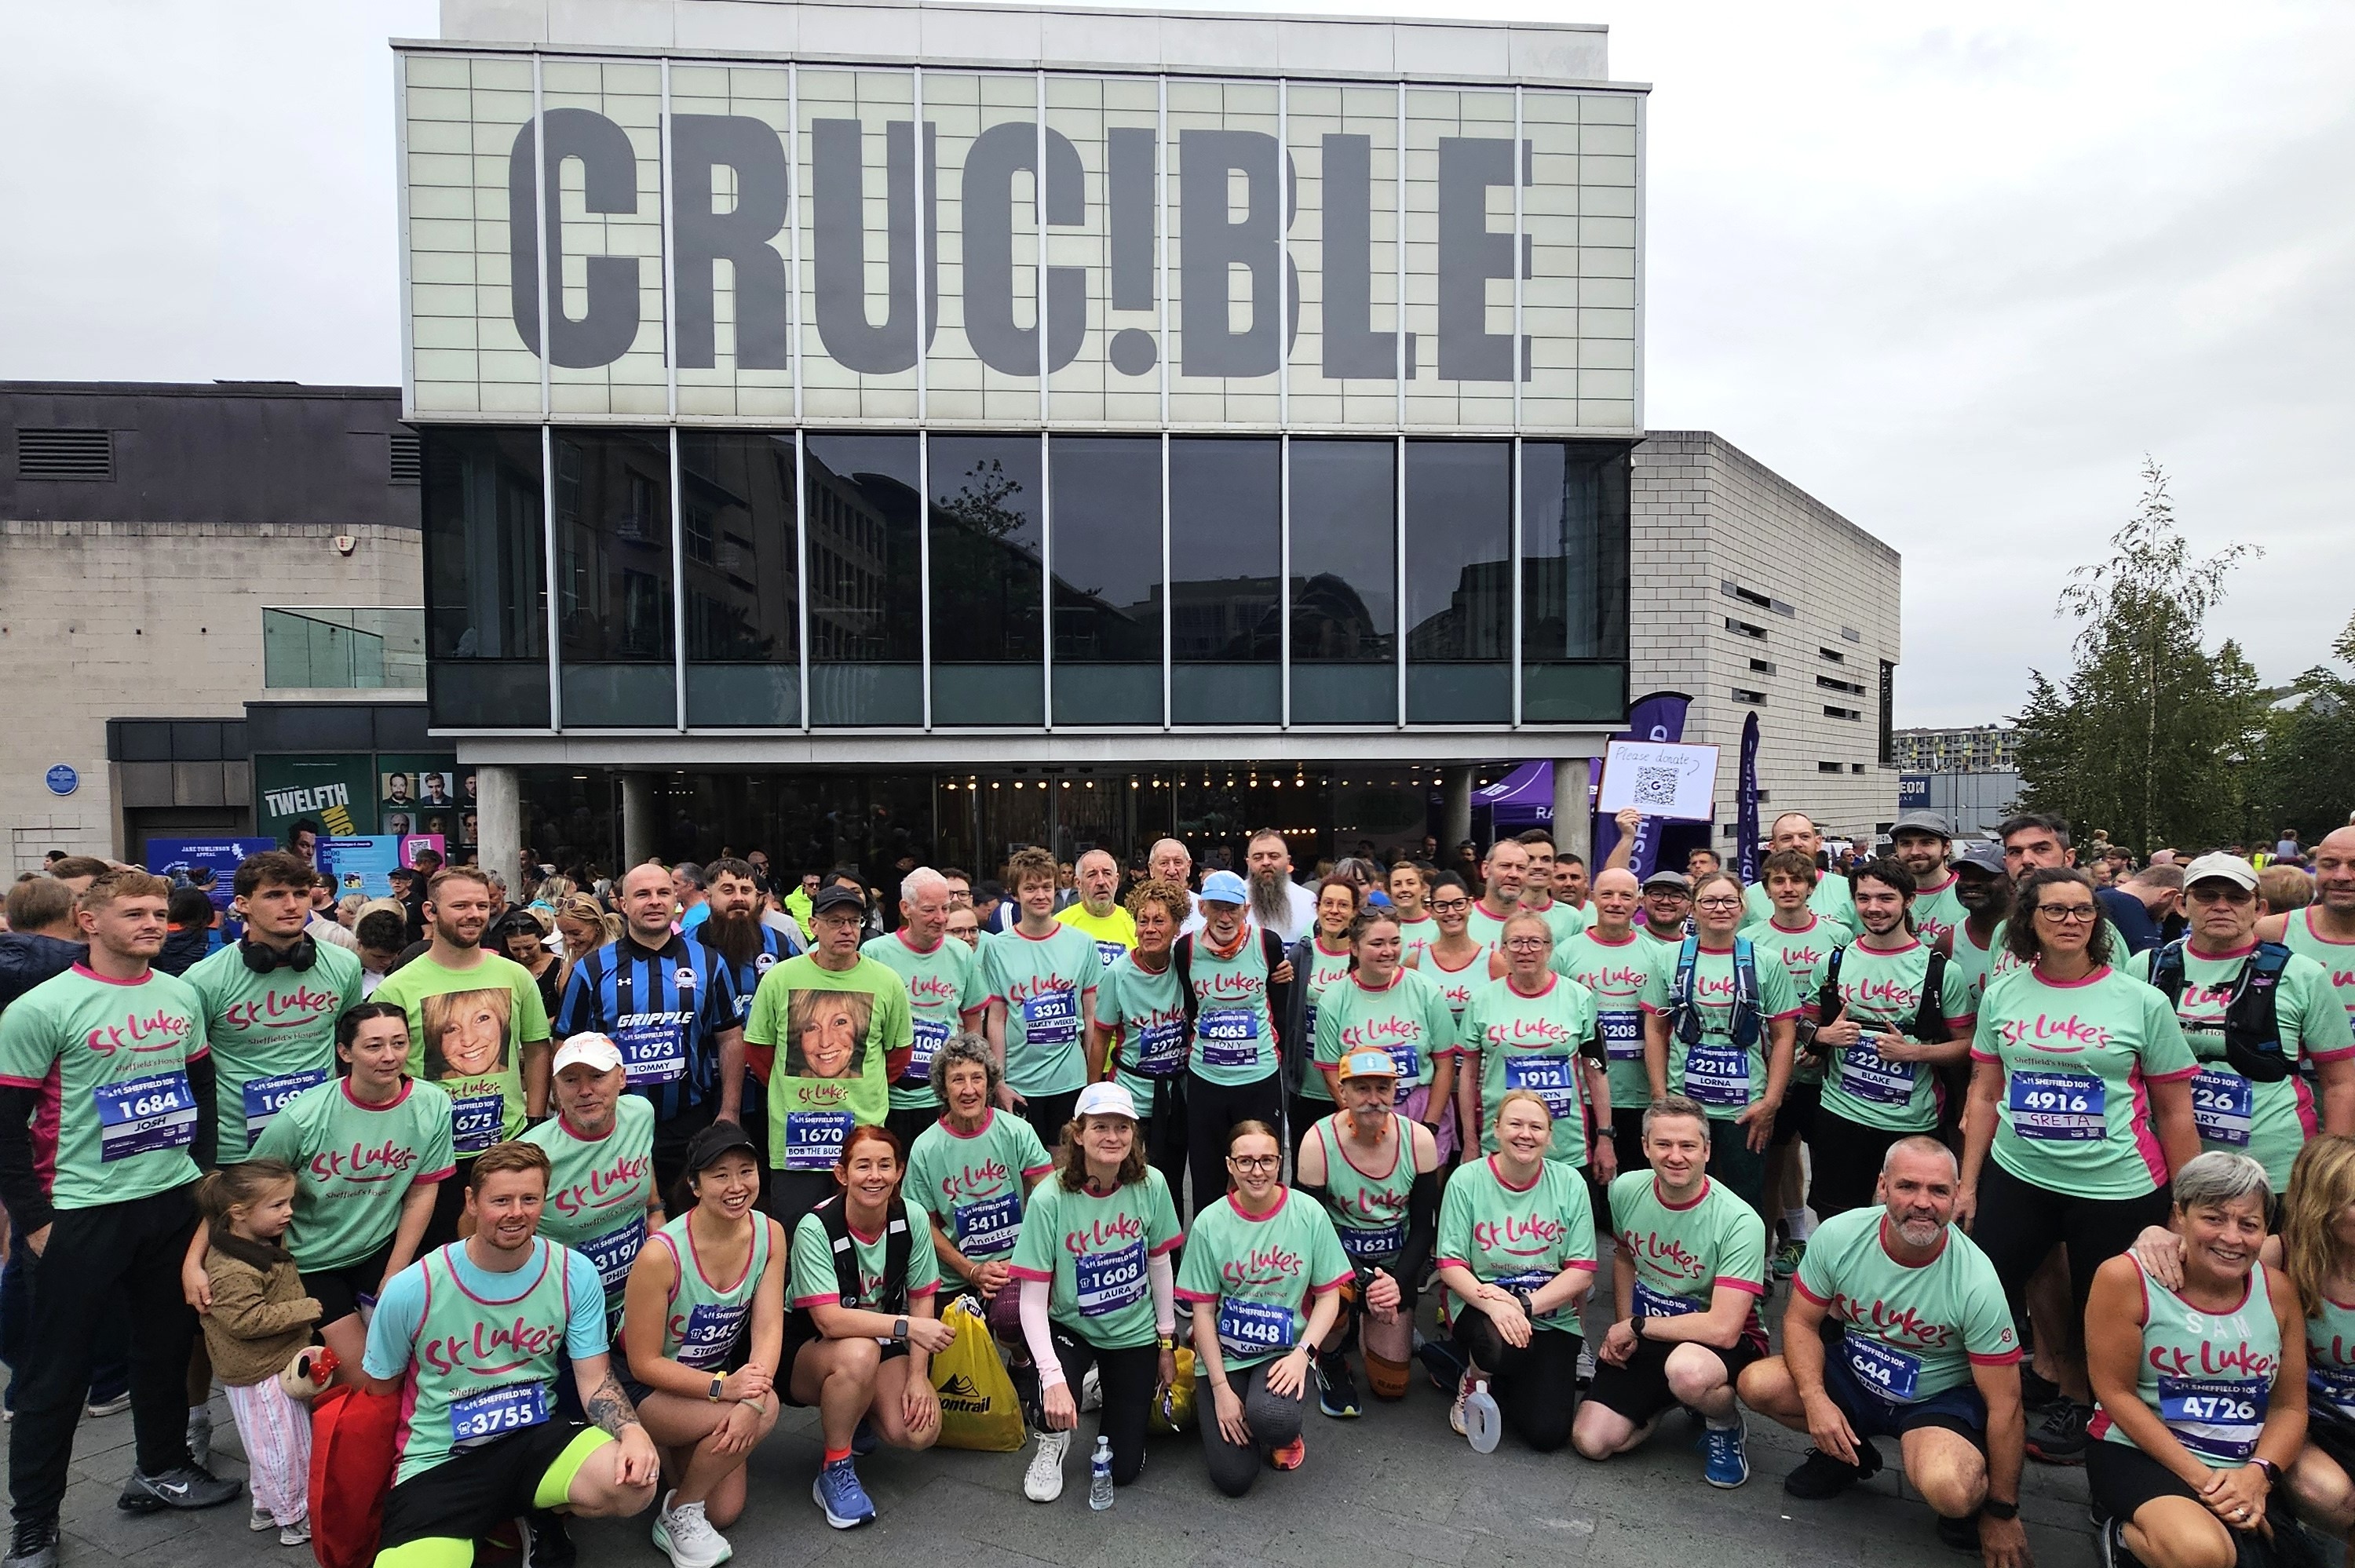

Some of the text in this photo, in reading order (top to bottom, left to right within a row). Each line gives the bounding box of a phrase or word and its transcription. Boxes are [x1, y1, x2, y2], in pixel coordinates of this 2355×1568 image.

[509, 108, 1532, 381] CRUC!BLE
[1615, 746, 1690, 765] Please donate
[1900, 782, 1925, 793] EON
[265, 783, 349, 817] TWELFTH
[321, 804, 358, 837] NIG
[911, 975, 957, 1001] Luke's
[1193, 971, 1264, 1000] St Luke's
[1861, 978, 1921, 1008] Luke's
[226, 986, 338, 1030] St Luke's
[1034, 1003, 1067, 1018] 3321
[617, 1011, 695, 1027] GRIPPLE
[88, 1009, 192, 1059] St Luke's
[633, 1031, 663, 1040] SHEFFIELD
[1209, 1025, 1247, 1037] 5065
[1342, 1016, 1422, 1050] St Luke's
[1487, 1018, 1570, 1047] St Luke's
[2001, 1013, 2114, 1048] St Luke's
[630, 1041, 674, 1059] 1673
[915, 1035, 942, 1051] 108
[1150, 1036, 1183, 1054] 5272
[1211, 1040, 1243, 1049] TONY
[115, 1060, 157, 1072] Sheffield's
[634, 1062, 670, 1073] TOMMY
[1695, 1059, 1738, 1075] 2214
[1856, 1052, 1903, 1074] 2216
[2014, 1056, 2057, 1067] Sheffield's
[122, 1078, 175, 1094] SHEFFIELD 10K
[266, 1078, 301, 1089] SHEFFIELD
[462, 1079, 501, 1096] Luke's
[1518, 1070, 1561, 1086] 1912
[1700, 1078, 1731, 1086] LORNA
[1861, 1072, 1891, 1085] BLAKE
[2035, 1078, 2073, 1088] SHEFFIELD
[2221, 1078, 2239, 1088] 10K
[798, 1084, 849, 1103] St Luke's
[2024, 1092, 2088, 1112] 4916
[119, 1092, 179, 1118] 1684
[134, 1117, 167, 1132] JOSH
[455, 1113, 492, 1130] 675
[2030, 1114, 2090, 1126] GRETA
[2194, 1113, 2220, 1125] ARY
[799, 1128, 843, 1142] 1670
[311, 1140, 418, 1182] St Luke's
[555, 1154, 648, 1218] St Luke's
[942, 1175, 962, 1202] St
[972, 1198, 1011, 1214] SHEFFIELD 10K
[968, 1211, 1009, 1231] 5411
[601, 1231, 630, 1248] SHEFFIELD
[967, 1228, 1013, 1245] Annette
[1474, 1213, 1567, 1251] St Luke's
[1065, 1230, 1090, 1256] St
[1354, 1238, 1393, 1252] 1621
[594, 1237, 639, 1271] 3197
[1097, 1249, 1138, 1267] SHEFFIELD 10K
[1625, 1230, 1706, 1279] St Luke's
[1092, 1263, 1137, 1288] 1608
[1223, 1245, 1303, 1288] St Luke's
[1099, 1286, 1131, 1300] LAURA
[1646, 1293, 1688, 1310] SHEFFIELD 10K
[1239, 1307, 1283, 1319] SHEFFIELD 10K
[1835, 1293, 1953, 1347] St Luke's
[1232, 1319, 1280, 1343] 1448
[2185, 1312, 2252, 1339] SAM
[425, 1317, 561, 1377] St Luke's
[1854, 1341, 1905, 1369] SHEFFIELD 10K
[1853, 1355, 1891, 1386] 644
[2149, 1346, 2195, 1377] St
[1857, 1376, 1884, 1395] DAVE
[2192, 1384, 2240, 1394] SHEFFIELD
[478, 1388, 532, 1407] SHEFFIELD 10K
[939, 1396, 991, 1413] ontrail
[2182, 1397, 2256, 1419] 4726
[472, 1404, 533, 1435] 3755
